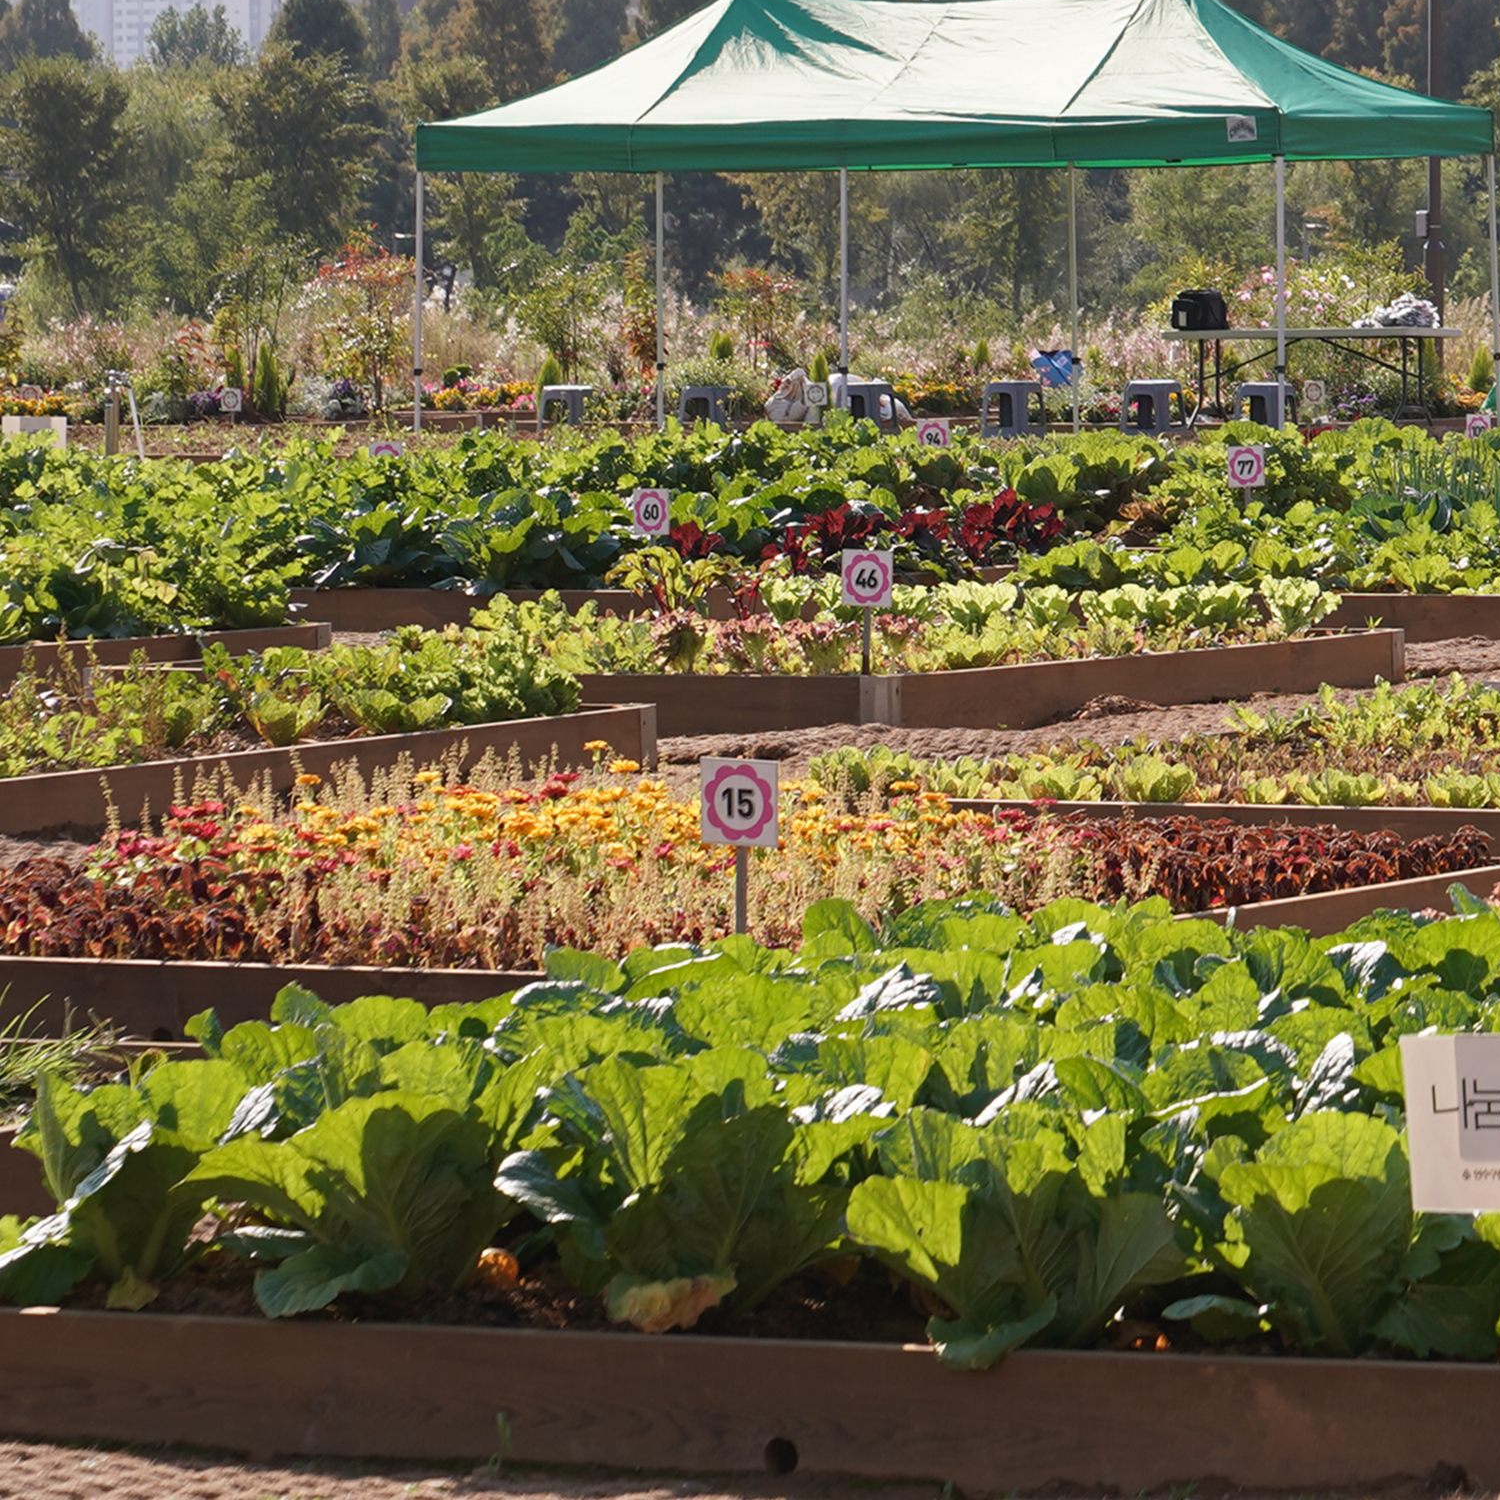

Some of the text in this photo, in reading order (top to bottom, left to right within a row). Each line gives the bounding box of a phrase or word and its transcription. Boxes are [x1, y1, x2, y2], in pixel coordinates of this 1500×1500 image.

[925, 432, 941, 446] 94
[1237, 459, 1255, 476] 77
[642, 503, 660, 521] 60
[854, 568, 878, 589] 46
[722, 788, 754, 819] 15
